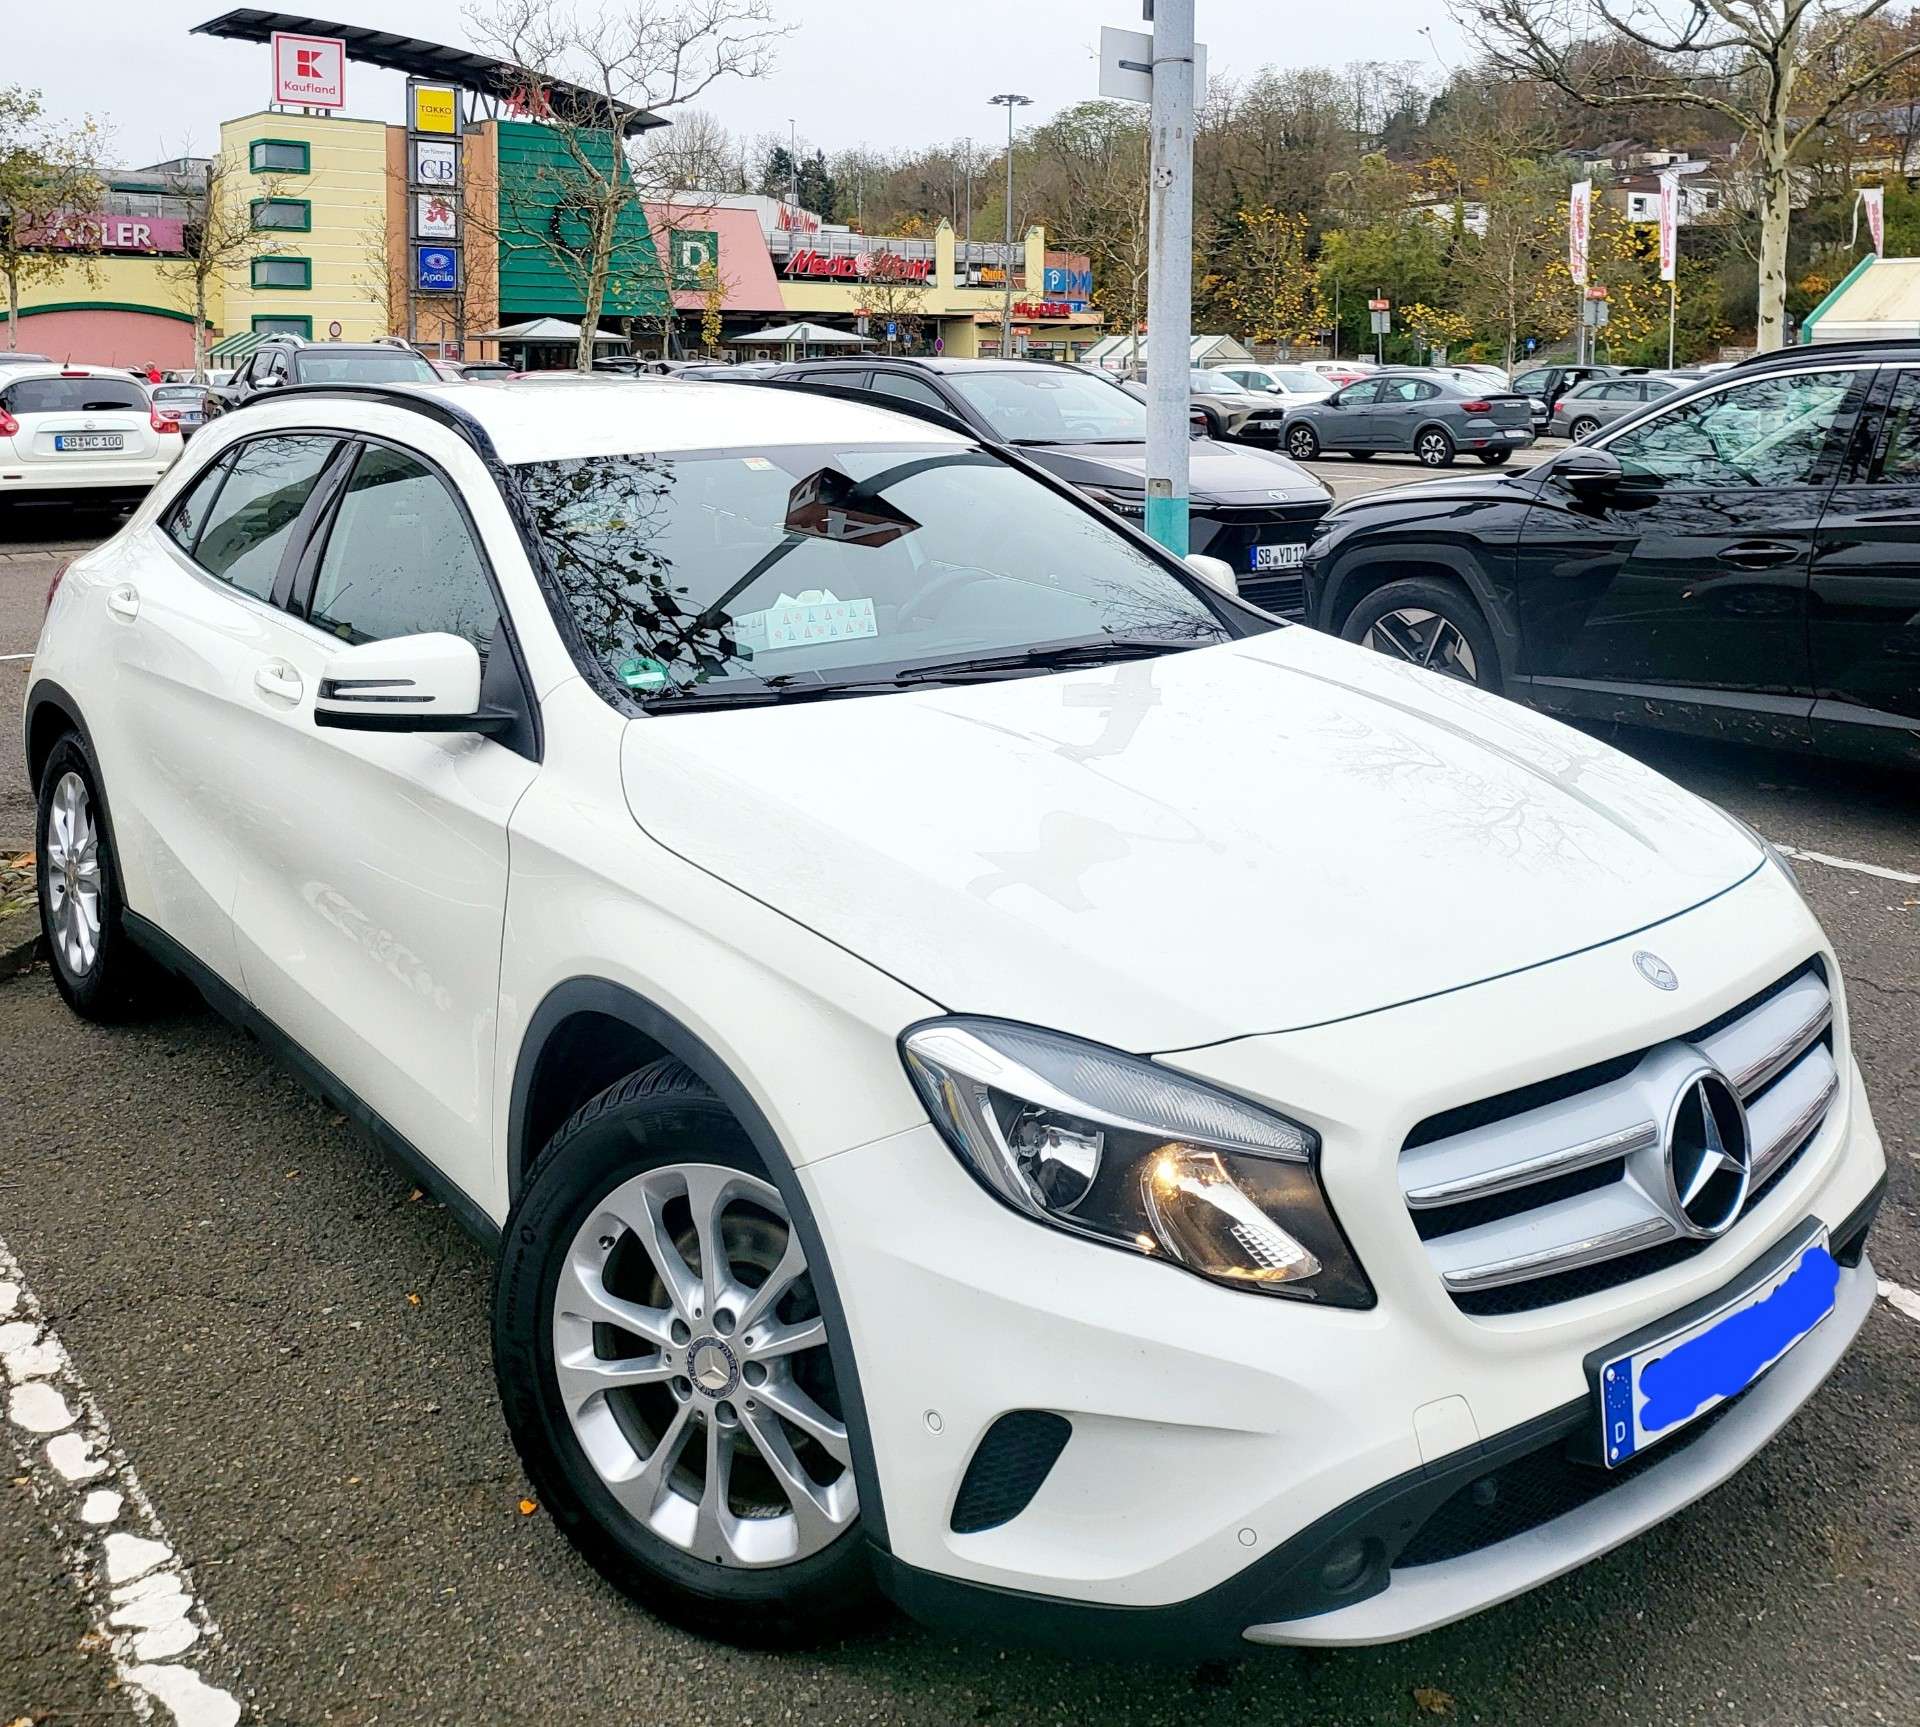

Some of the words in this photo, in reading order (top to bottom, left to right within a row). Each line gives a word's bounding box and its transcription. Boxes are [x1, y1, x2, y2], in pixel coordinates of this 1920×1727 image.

[284, 80, 336, 95] Kaufland
[63, 220, 151, 247] DLER
[784, 249, 857, 277] Media
[422, 271, 454, 282] Apollo
[63, 437, 77, 448] SB
[85, 437, 99, 447] WC
[102, 436, 121, 447] 100
[1258, 548, 1271, 565] SB
[1614, 1421, 1626, 1443] D
